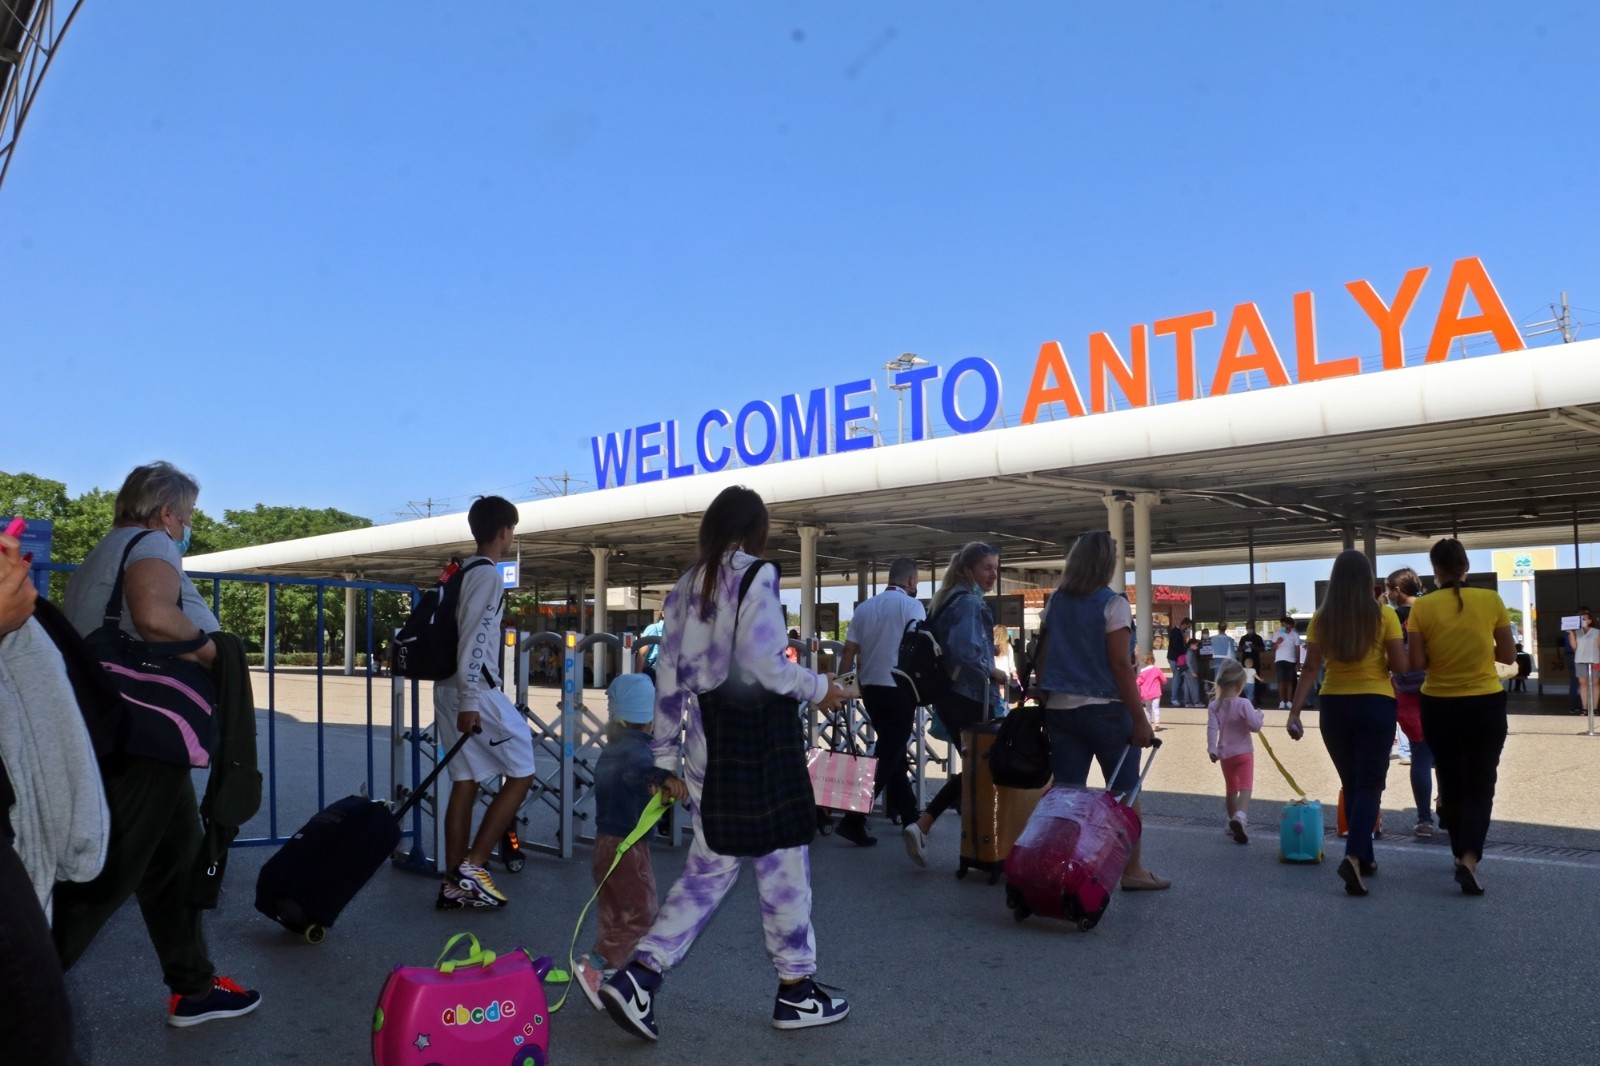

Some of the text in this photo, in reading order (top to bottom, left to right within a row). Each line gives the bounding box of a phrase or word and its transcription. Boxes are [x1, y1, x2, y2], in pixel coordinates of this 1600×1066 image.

[592, 256, 1527, 490] WELCOME TO ANTALYA
[467, 604, 496, 683] SWOOSH
[442, 1000, 516, 1026] abcde
